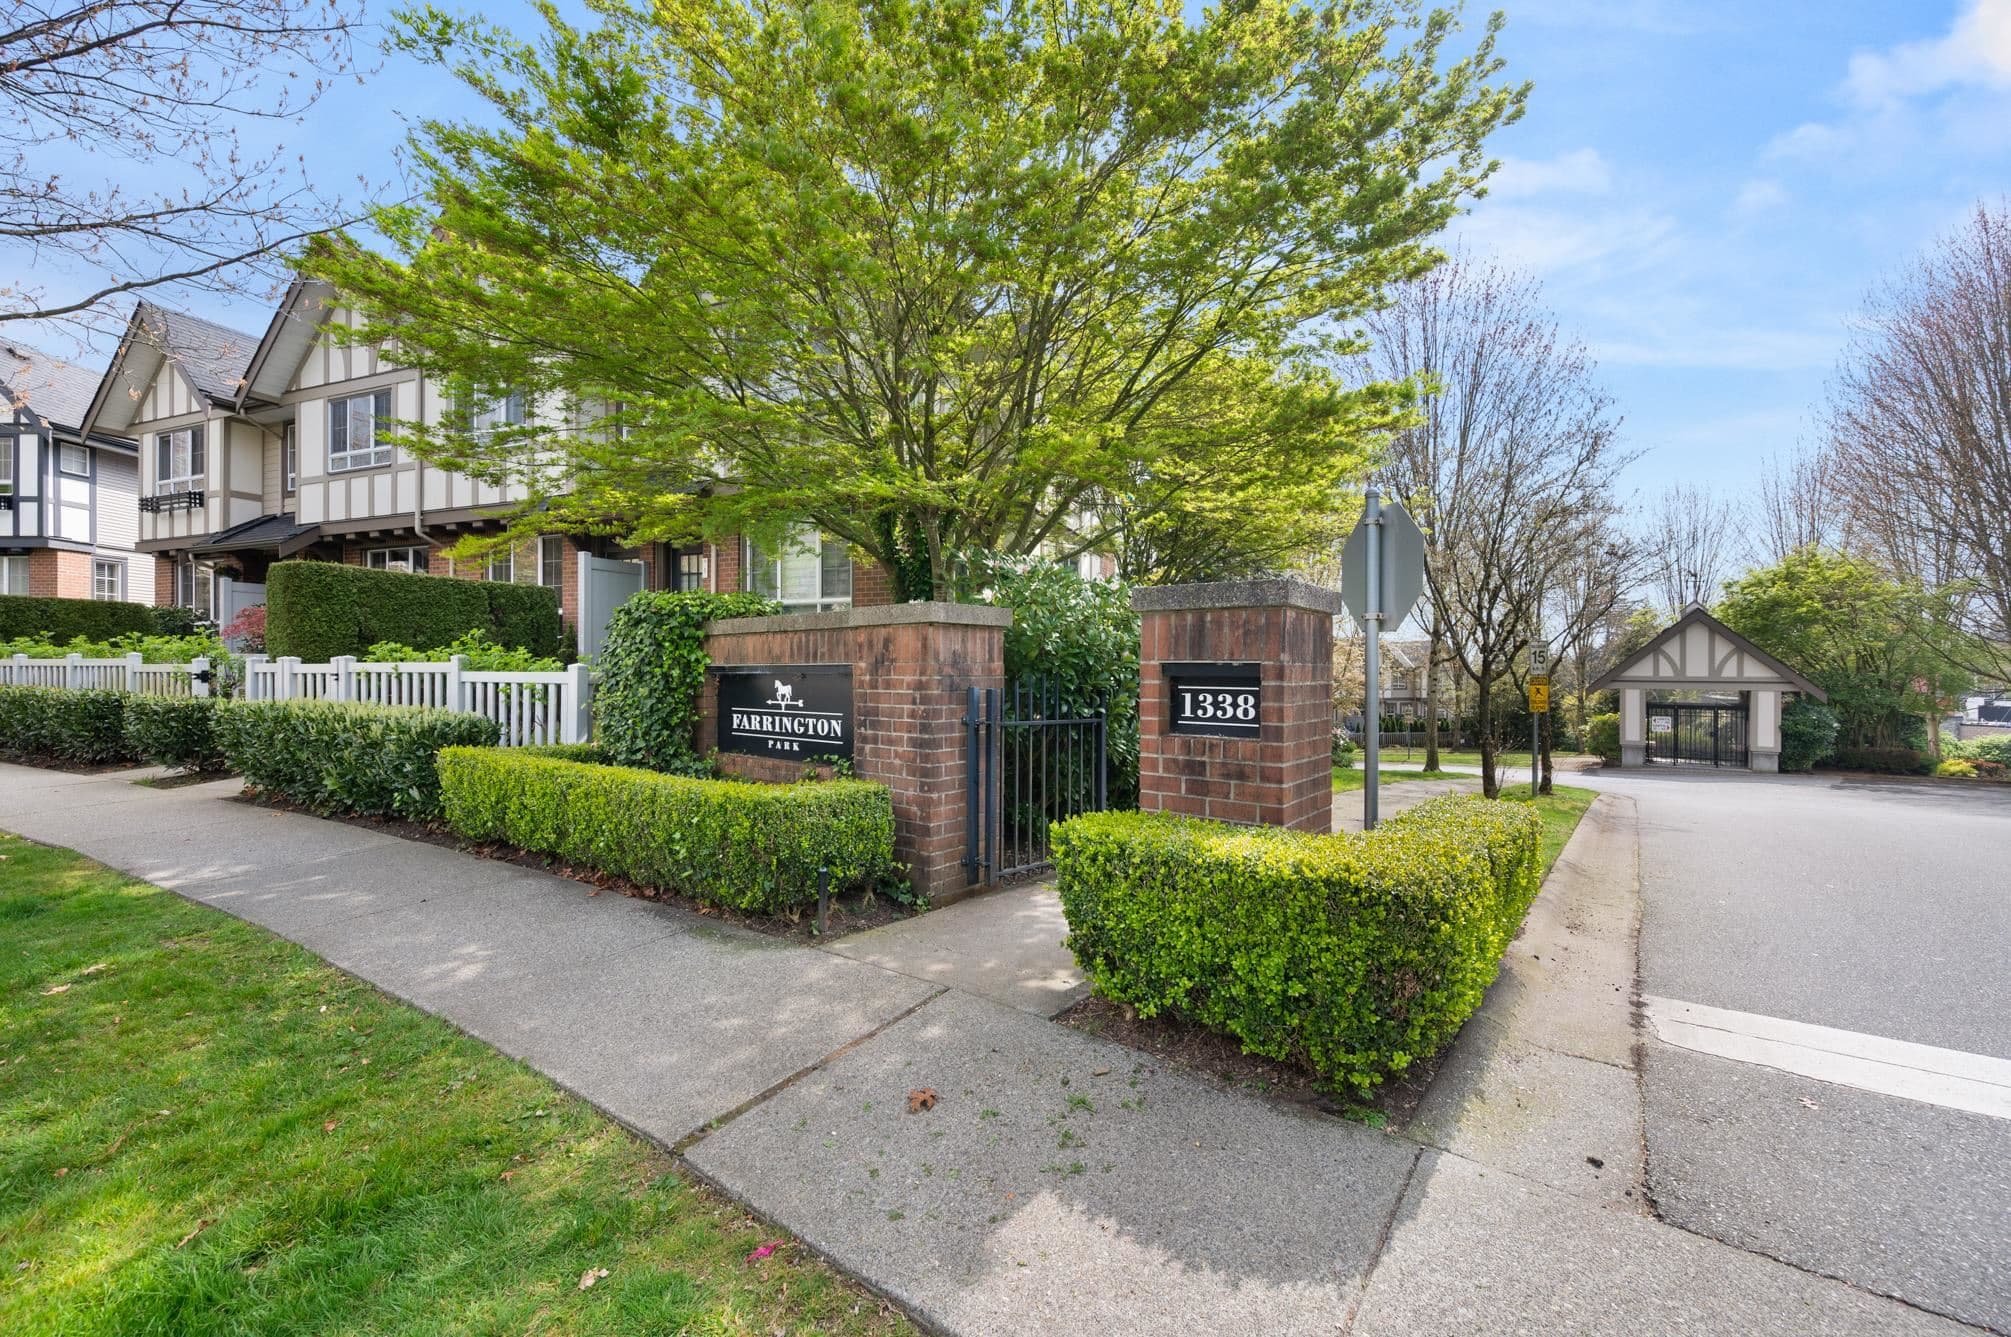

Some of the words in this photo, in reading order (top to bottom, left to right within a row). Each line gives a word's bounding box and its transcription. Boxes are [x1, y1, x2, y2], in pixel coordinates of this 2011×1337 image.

[1532, 650, 1545, 664] 15
[1181, 693, 1256, 720] 1338
[732, 713, 842, 737] FARRINGTON
[768, 740, 800, 751] PARK
